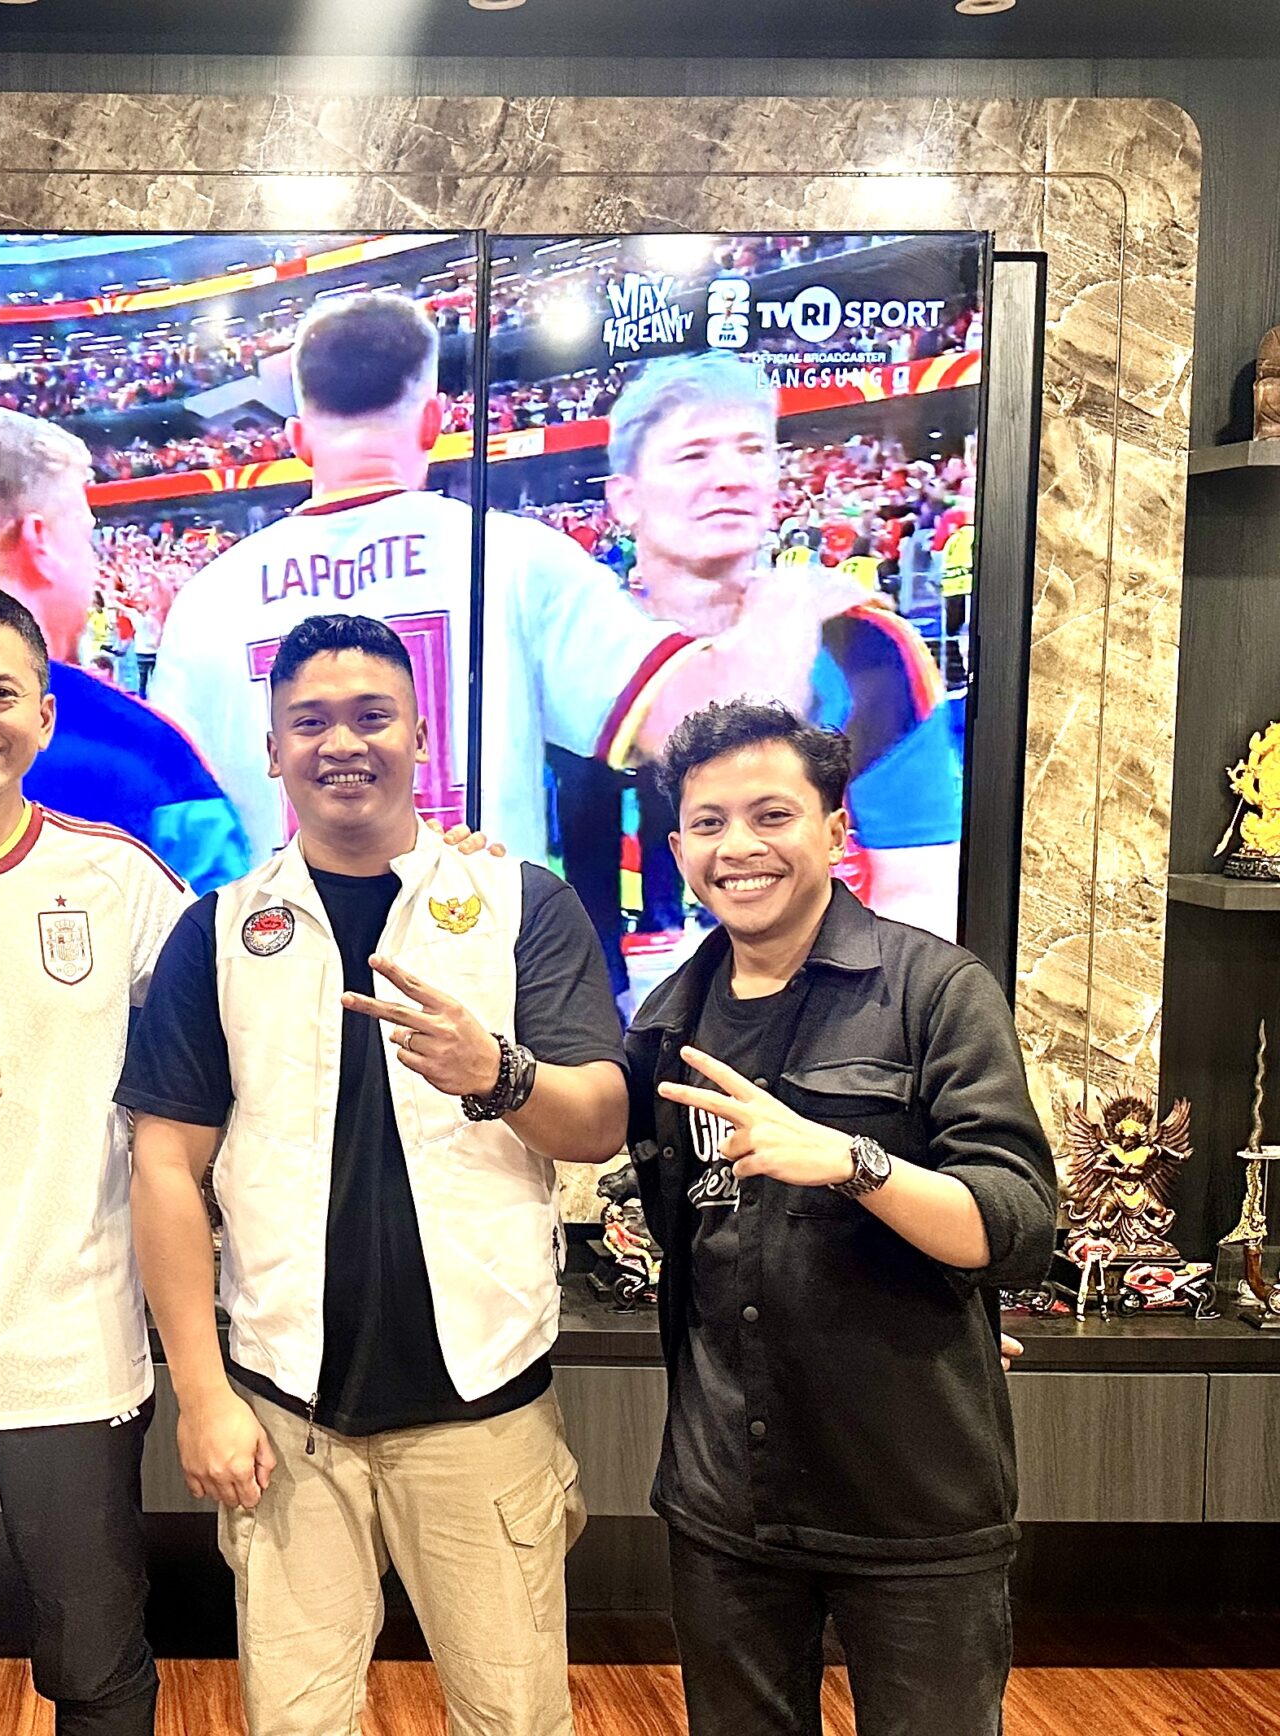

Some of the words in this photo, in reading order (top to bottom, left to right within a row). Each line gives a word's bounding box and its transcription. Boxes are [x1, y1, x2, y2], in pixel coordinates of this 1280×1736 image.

[606, 272, 674, 321] MAX
[756, 299, 833, 330] TVRI
[843, 300, 945, 328] SPORT
[603, 304, 685, 357] STREAM
[719, 333, 737, 342] FIFA
[752, 352, 802, 363] OFFICIAL
[803, 352, 887, 363] BROADCASTER
[756, 366, 883, 389] LANGSUNG
[261, 533, 427, 605] LAPORTE
